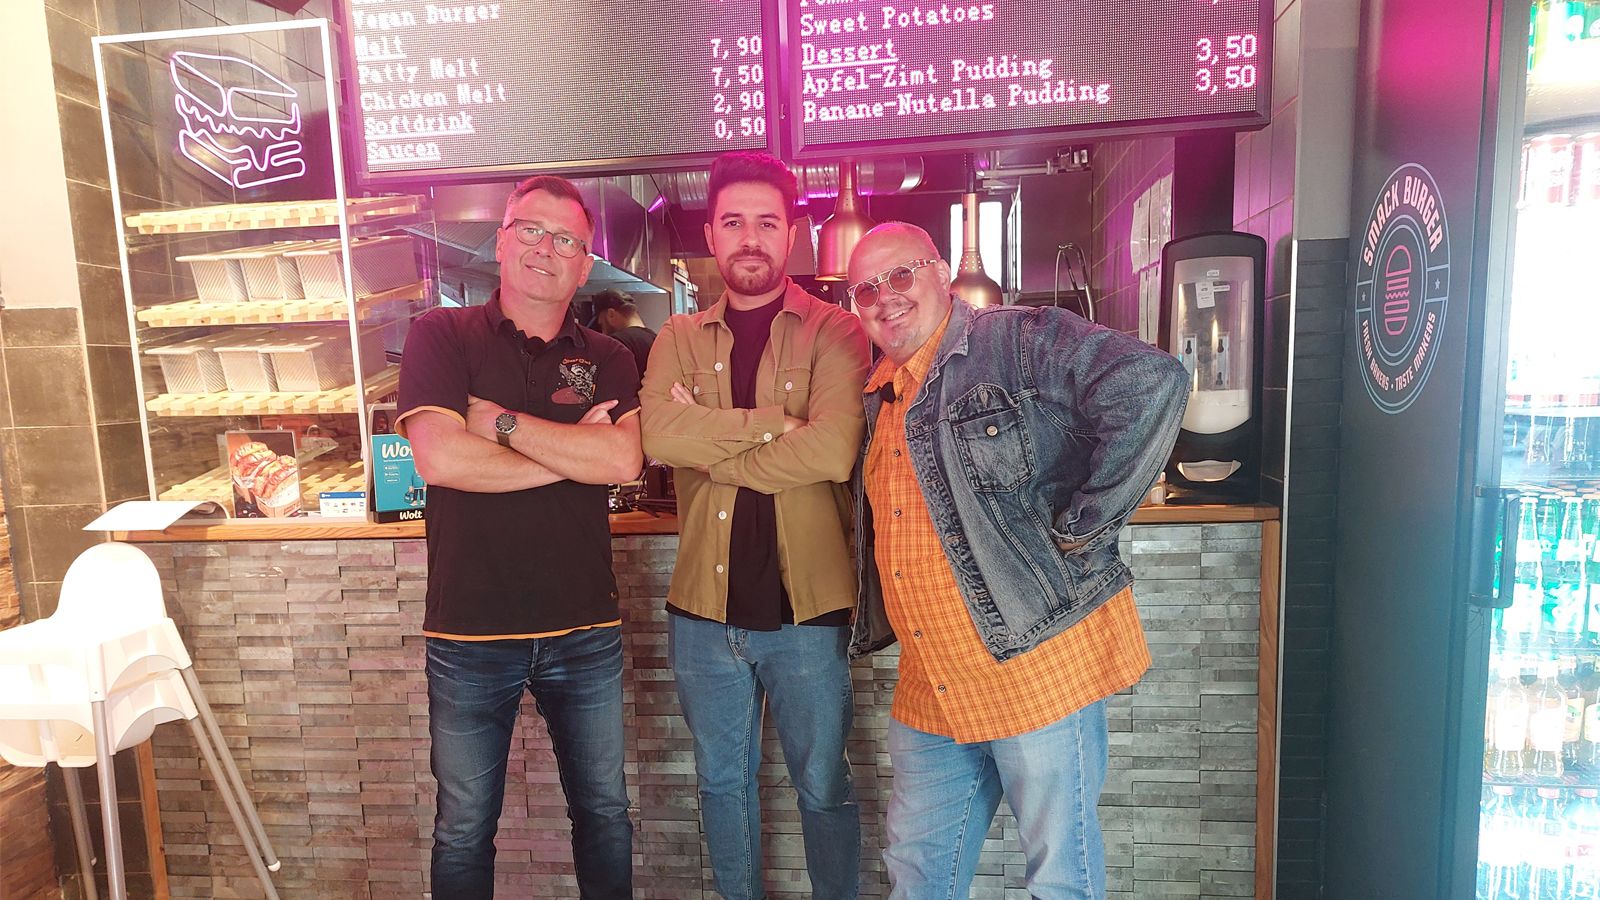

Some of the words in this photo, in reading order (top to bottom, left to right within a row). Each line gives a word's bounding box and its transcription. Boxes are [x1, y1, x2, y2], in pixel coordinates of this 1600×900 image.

[352, 10, 416, 30] Vegan
[425, 4, 500, 24] Burger
[800, 11, 868, 36] Sweet
[882, 3, 994, 29] Potatoes
[354, 35, 403, 57] Melt
[802, 38, 898, 66] Dessert
[357, 63, 418, 84] Patty
[430, 57, 480, 79] Melt
[802, 64, 938, 98] Apfel-Zimt
[951, 54, 1053, 82] Pudding
[360, 89, 448, 111] Chicken
[456, 83, 506, 105] Melt
[802, 89, 996, 123] Banane-Nutella
[1007, 79, 1110, 106] Pudding
[364, 110, 474, 136] Softdrink
[367, 141, 441, 160] Saucen
[1363, 180, 1400, 267] SMACK
[1403, 175, 1443, 253] BURGER
[1369, 357, 1390, 391] BAKERS
[1395, 365, 1414, 392] TASTE
[1413, 311, 1436, 372] MAKERS
[381, 441, 414, 459] Wo
[400, 509, 423, 520] Wolt
